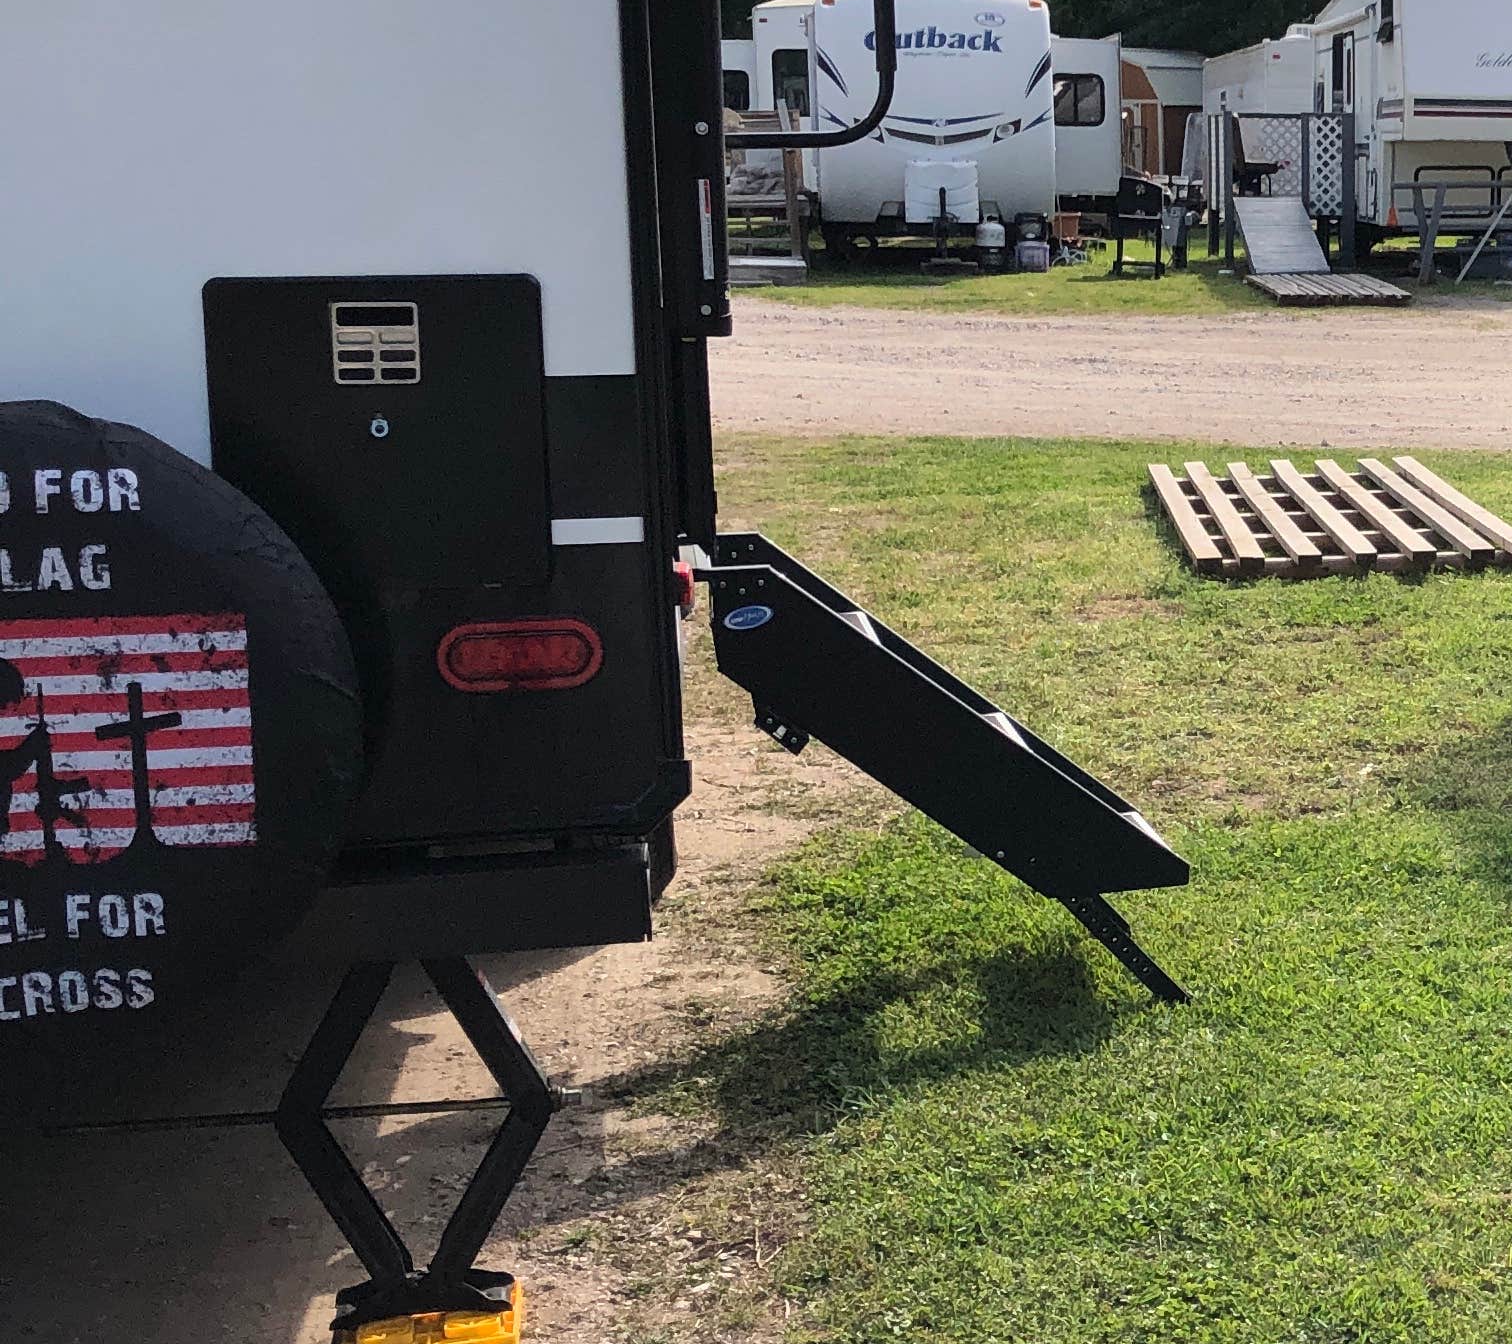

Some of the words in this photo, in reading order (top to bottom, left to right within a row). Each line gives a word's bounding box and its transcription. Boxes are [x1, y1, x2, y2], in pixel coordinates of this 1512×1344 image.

[34, 467, 142, 514] FOR
[65, 892, 167, 939] FOR
[0, 967, 156, 1021] CROSS
